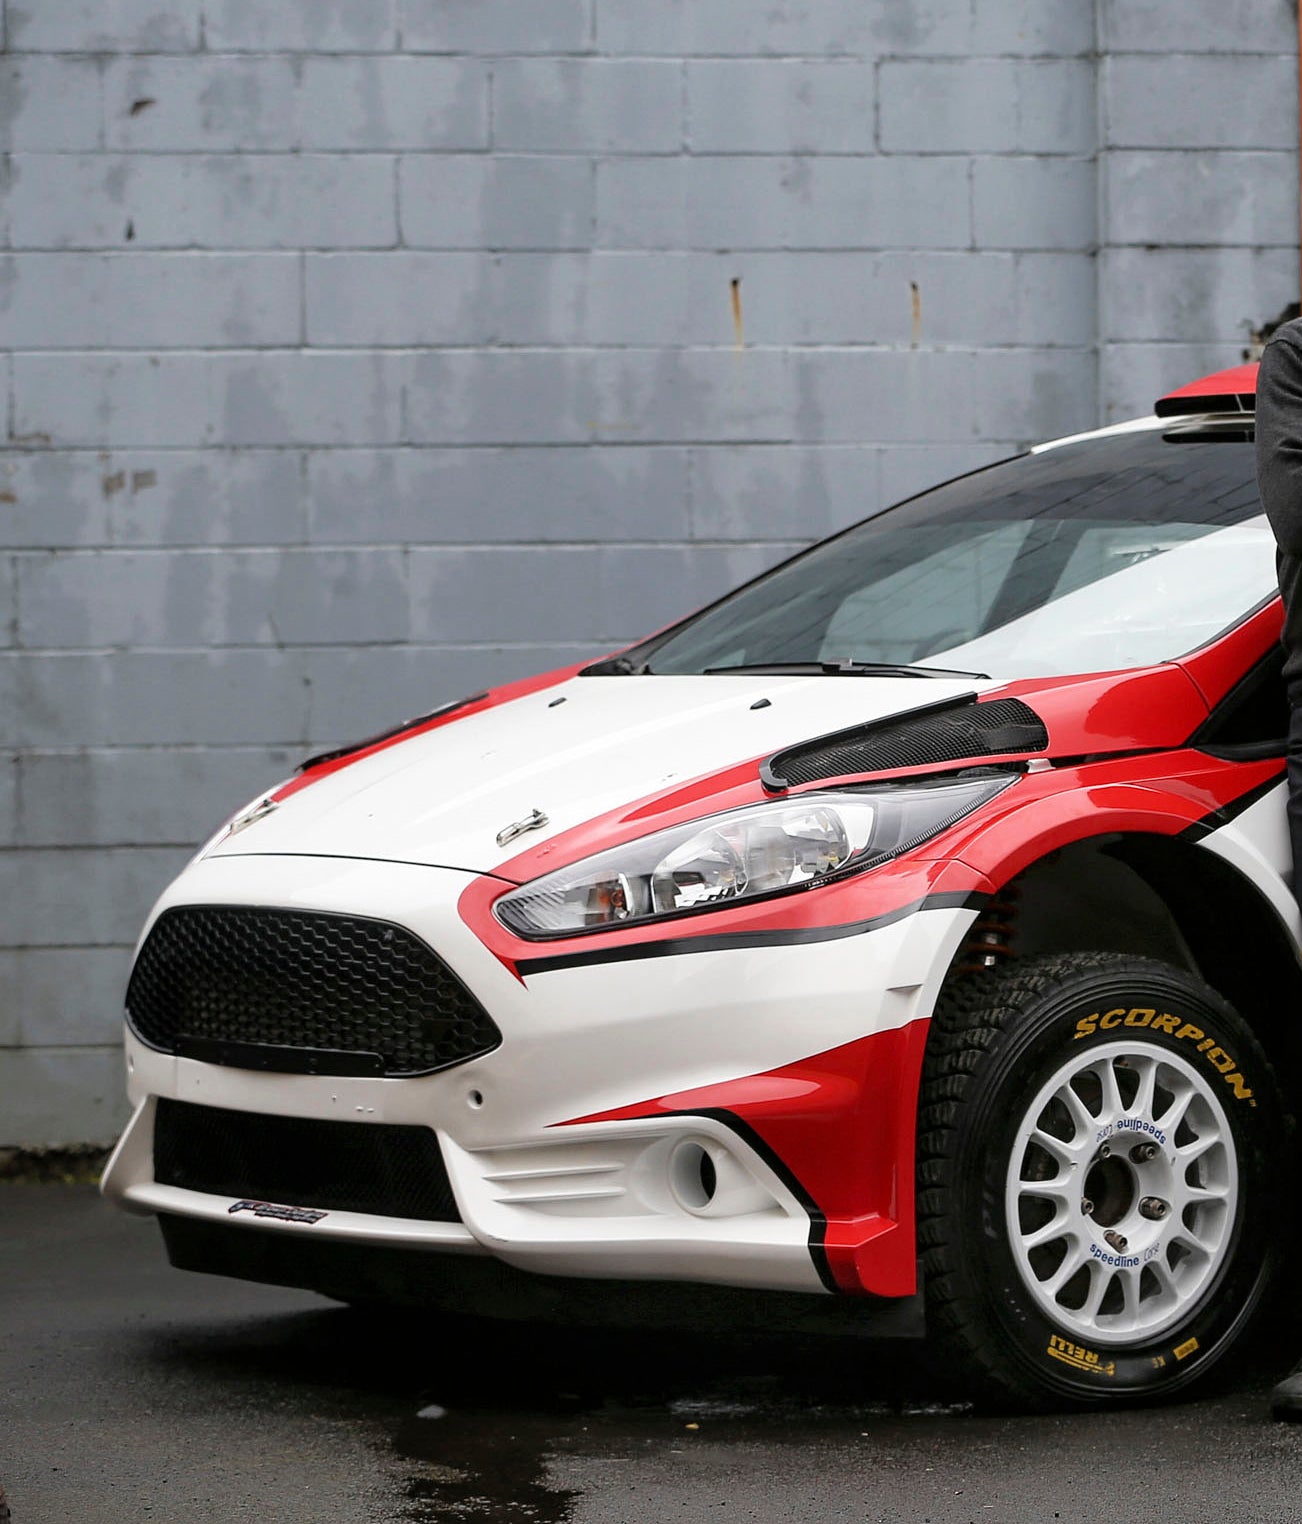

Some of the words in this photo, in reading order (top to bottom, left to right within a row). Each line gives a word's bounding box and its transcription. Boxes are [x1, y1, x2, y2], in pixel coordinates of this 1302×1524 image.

[1073, 1009, 1253, 1100] SCORPION
[1116, 1116, 1167, 1144] speedline
[1089, 1243, 1140, 1267] speedline
